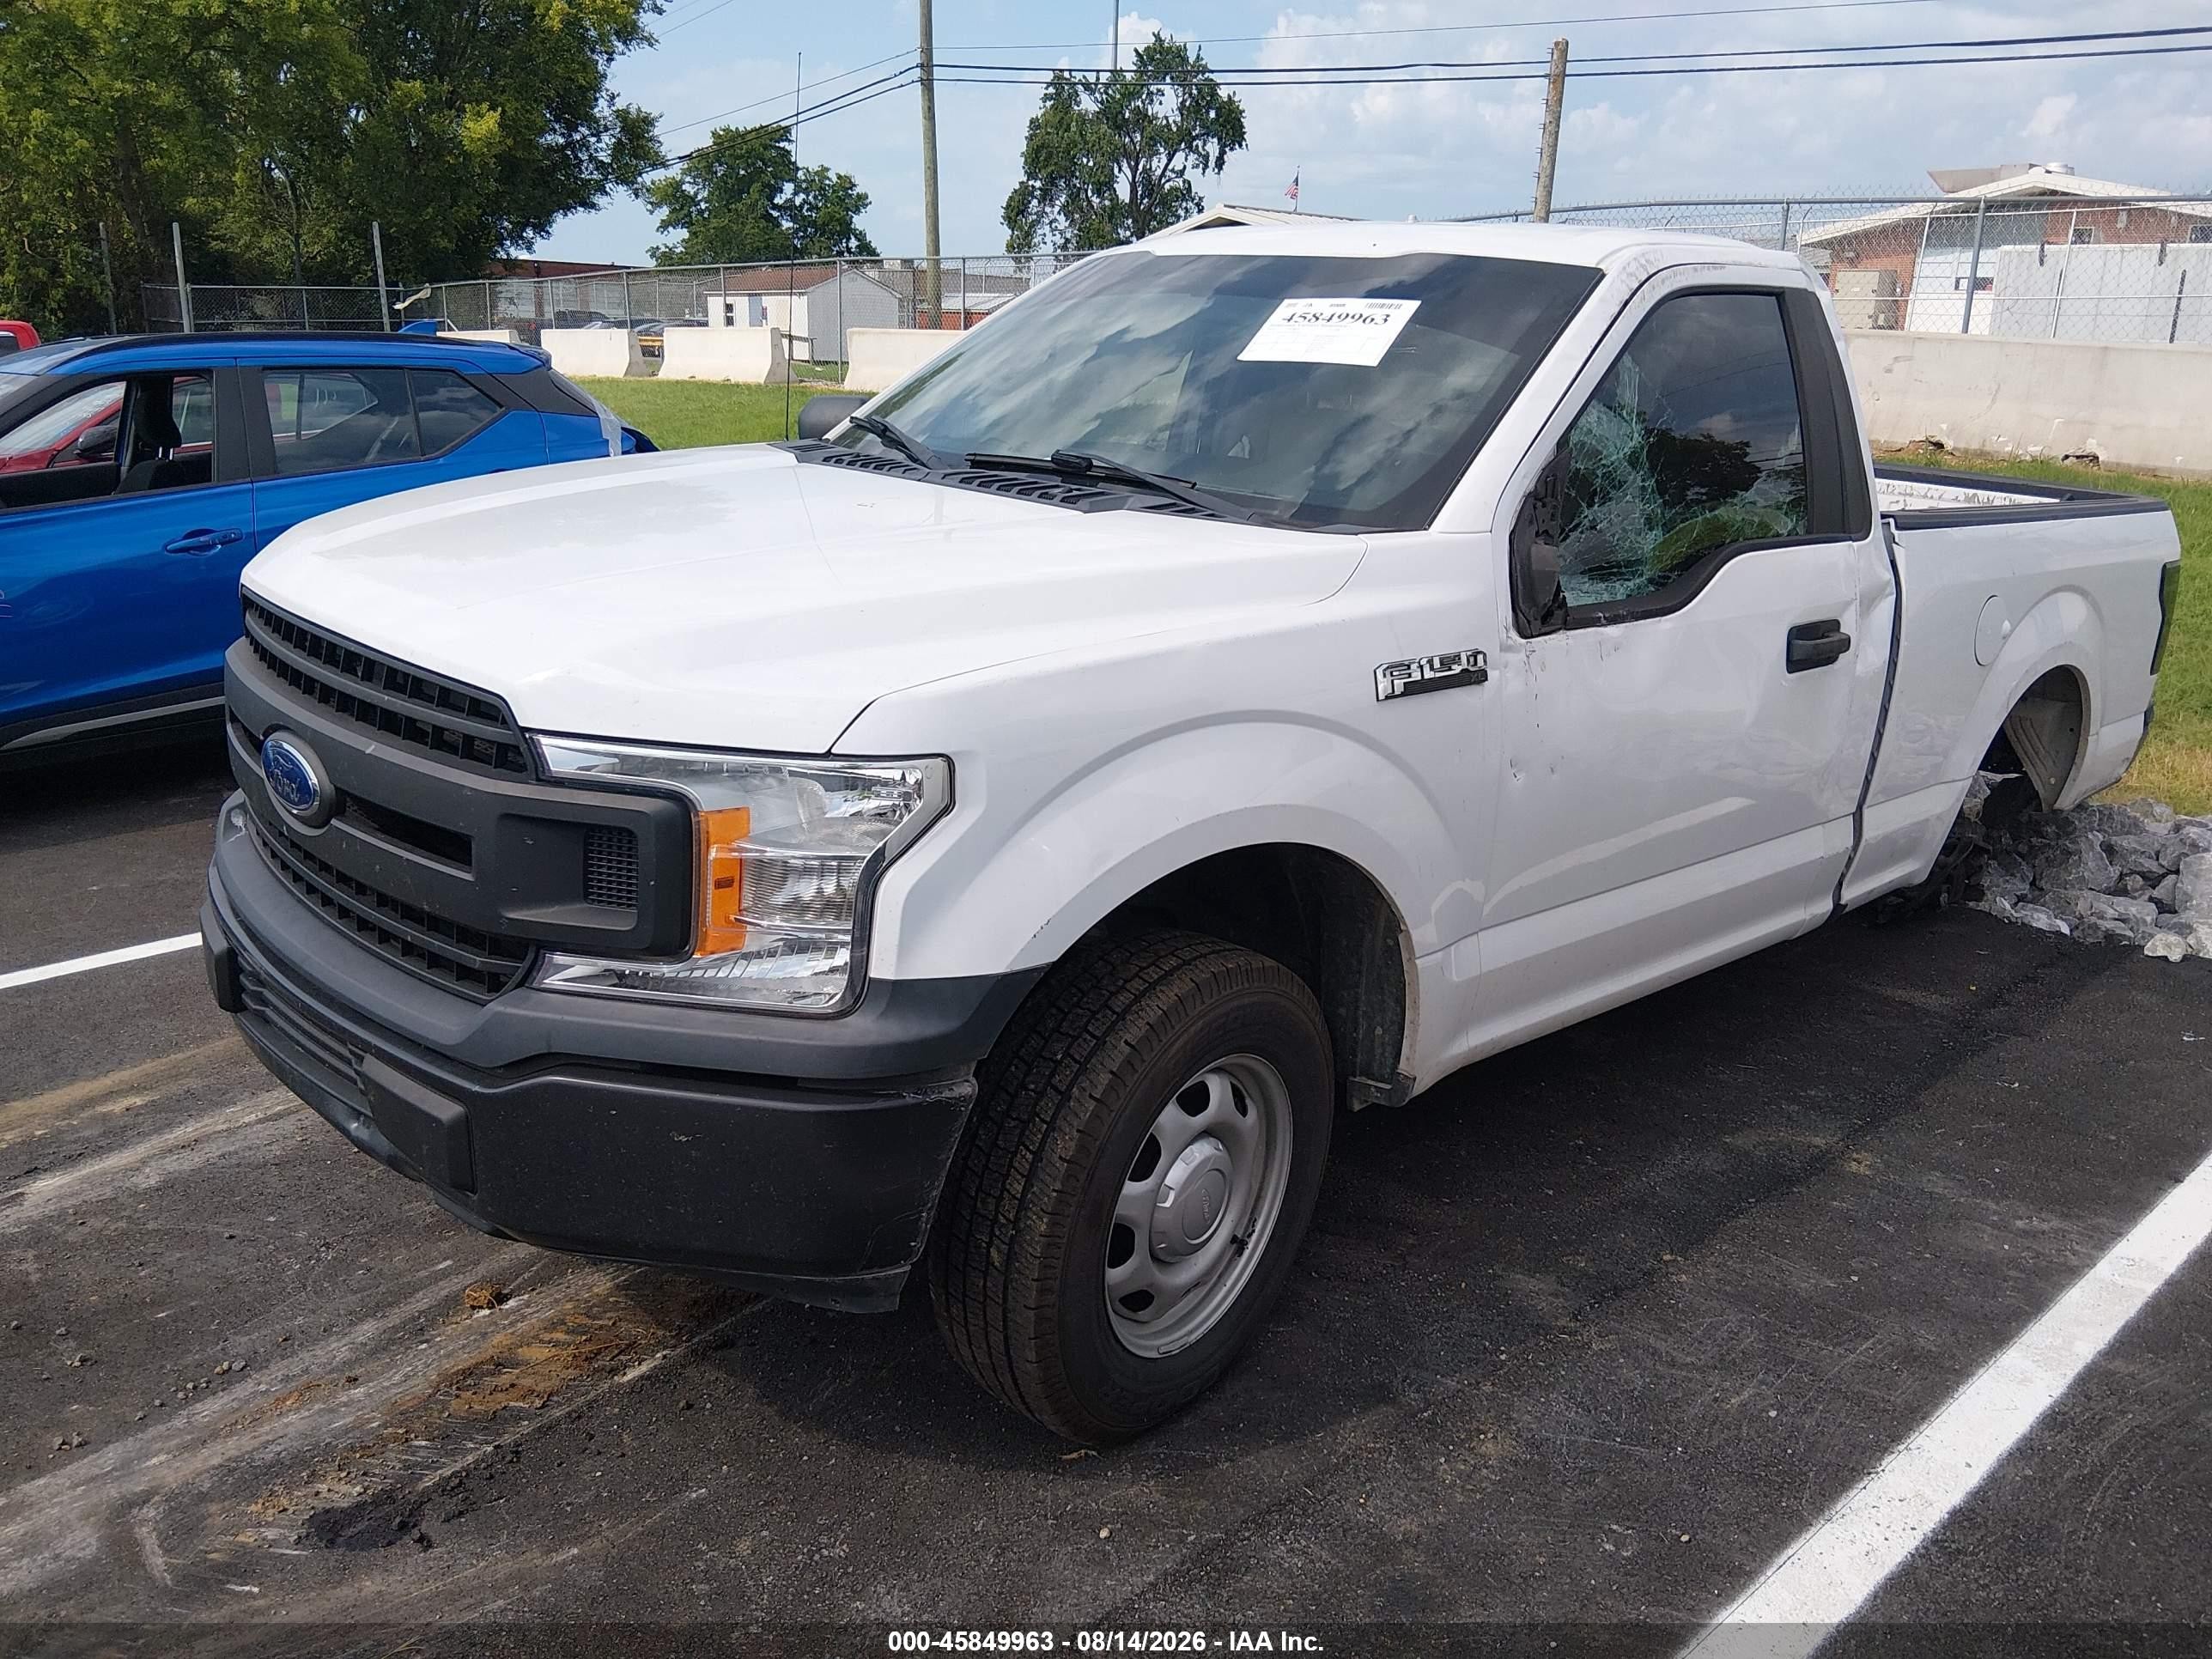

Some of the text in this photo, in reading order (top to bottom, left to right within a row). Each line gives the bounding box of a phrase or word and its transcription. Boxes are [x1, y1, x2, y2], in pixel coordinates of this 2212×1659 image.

[1282, 311, 1391, 325] 45849963
[1470, 672, 1486, 683] XL
[268, 753, 301, 803] Ford
